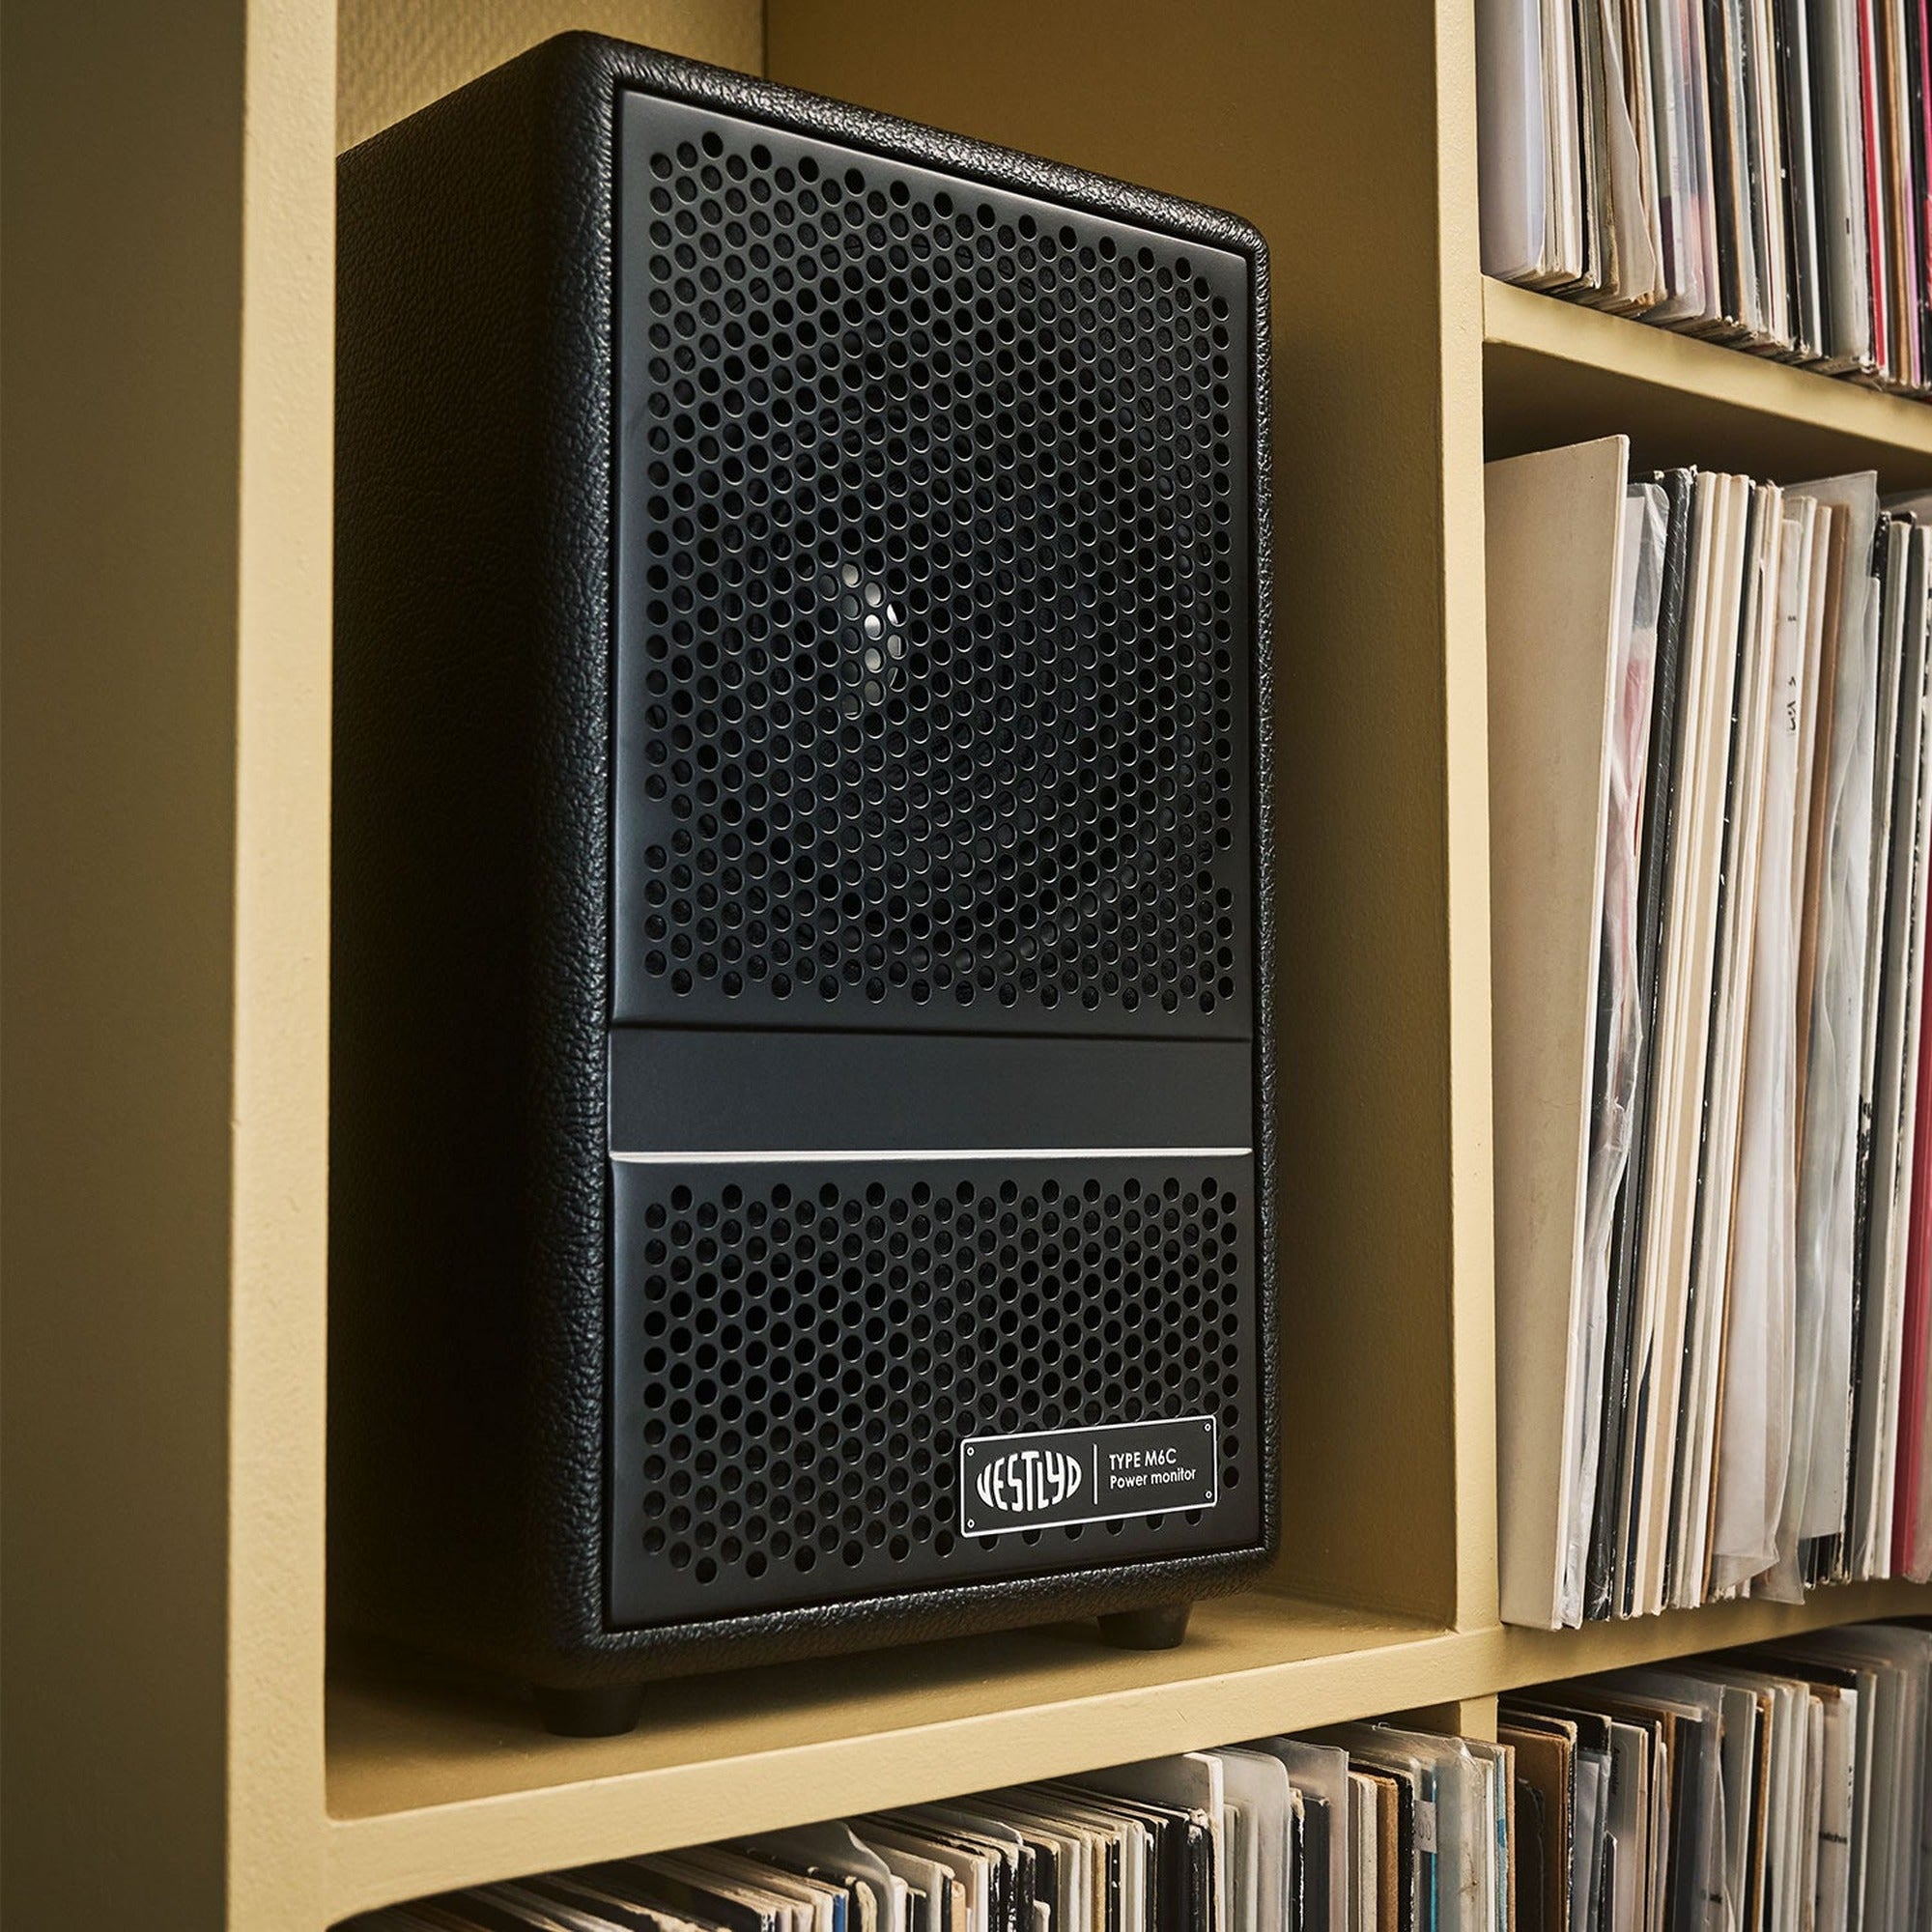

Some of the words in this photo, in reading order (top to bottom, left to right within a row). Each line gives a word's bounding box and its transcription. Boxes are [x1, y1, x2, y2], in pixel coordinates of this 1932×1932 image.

[1109, 1452, 1141, 1470] TYPE
[1145, 1448, 1177, 1466] M6C
[977, 1450, 1082, 1512] VESTLYD
[1110, 1475, 1148, 1490] Power
[1151, 1467, 1196, 1484] monitor
